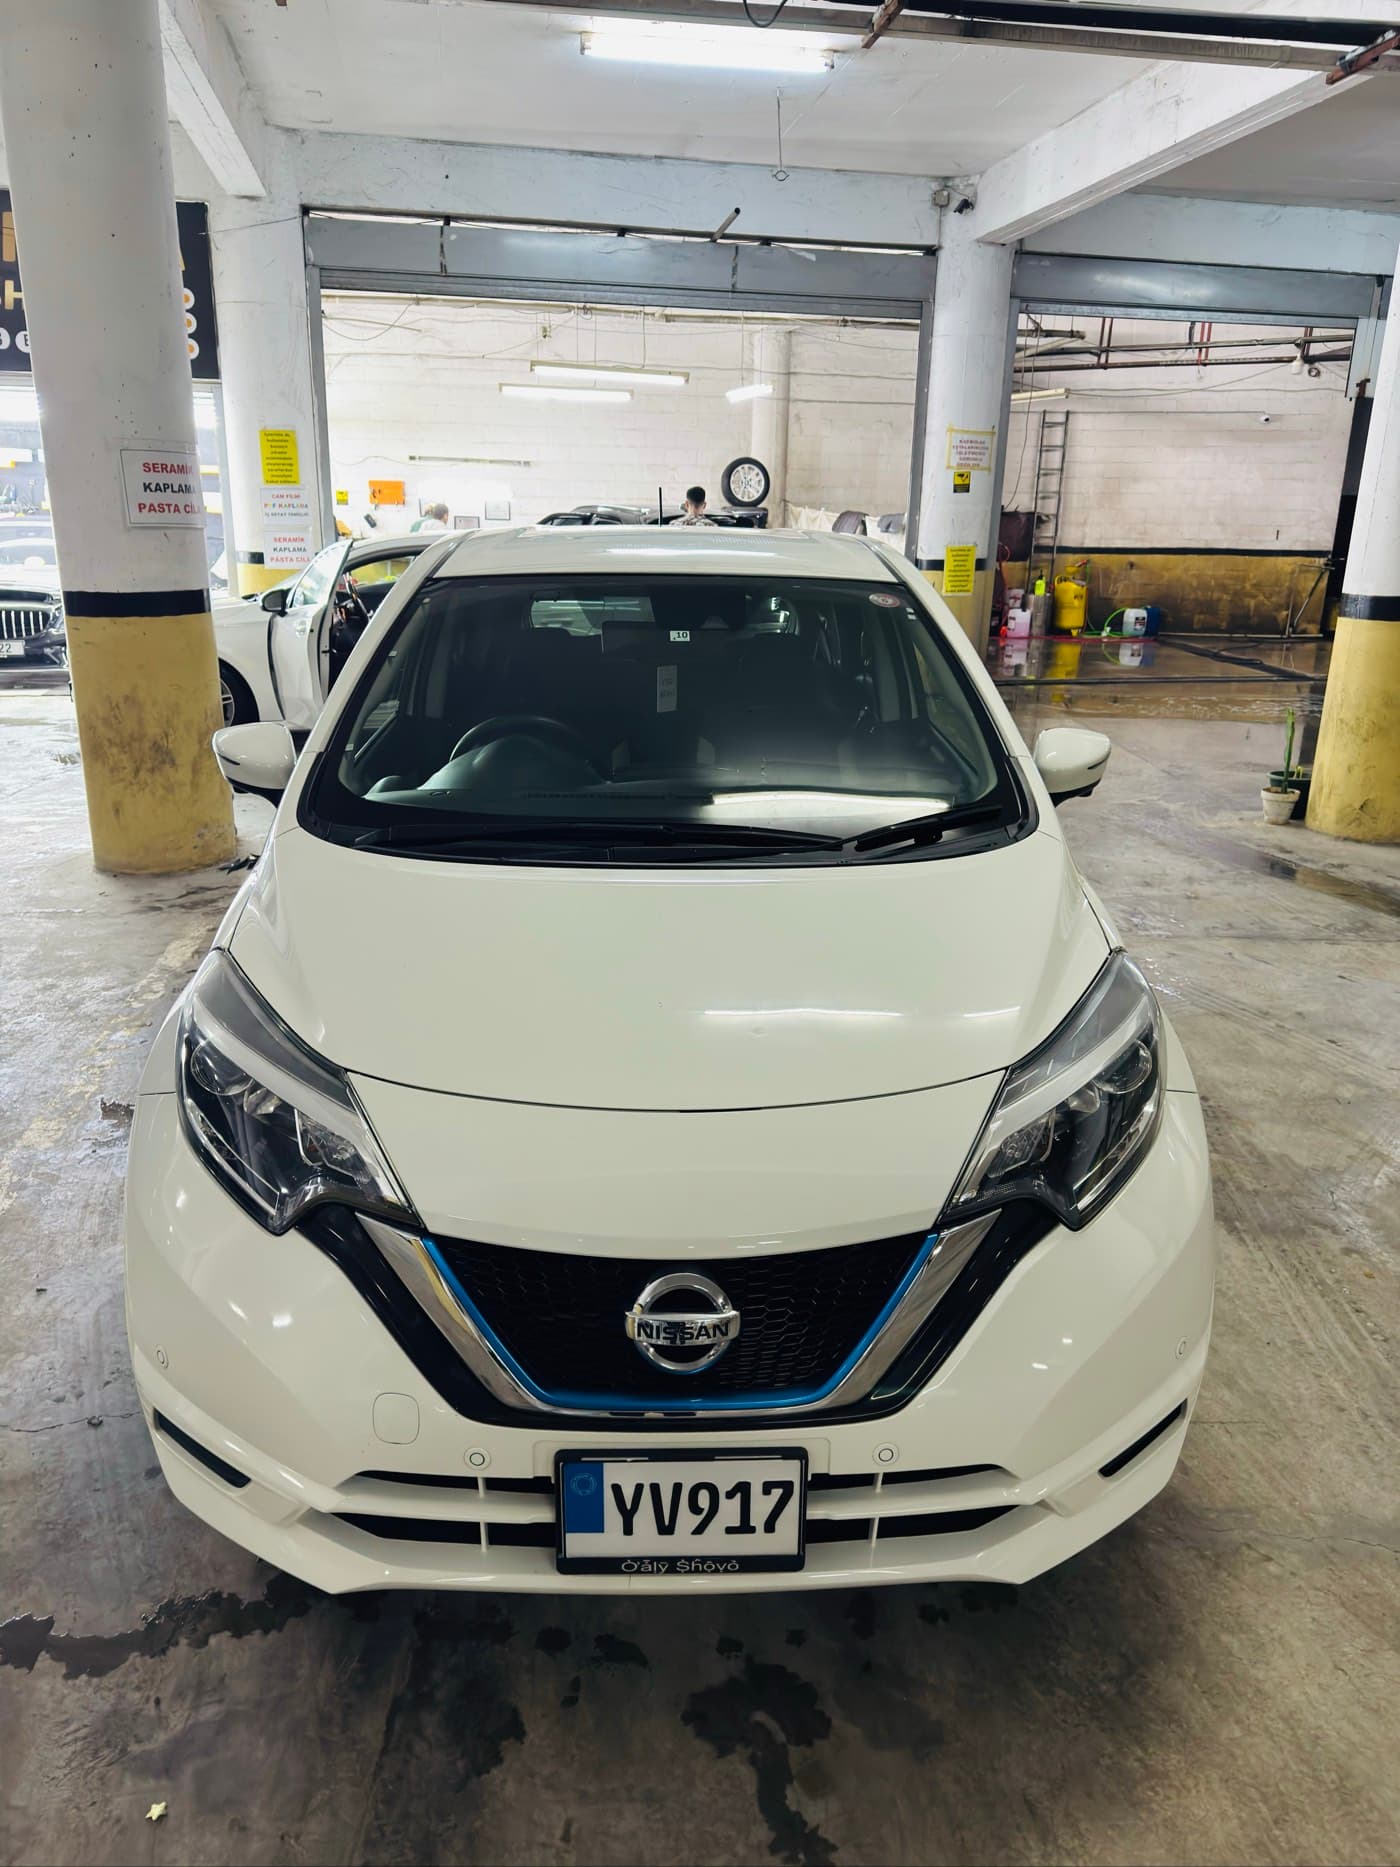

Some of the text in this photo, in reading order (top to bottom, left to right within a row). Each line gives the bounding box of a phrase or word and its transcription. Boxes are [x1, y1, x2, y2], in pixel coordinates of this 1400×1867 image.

[137, 502, 181, 514] PASTA
[637, 1320, 729, 1341] NISSAN
[610, 1481, 795, 1537] YV917
